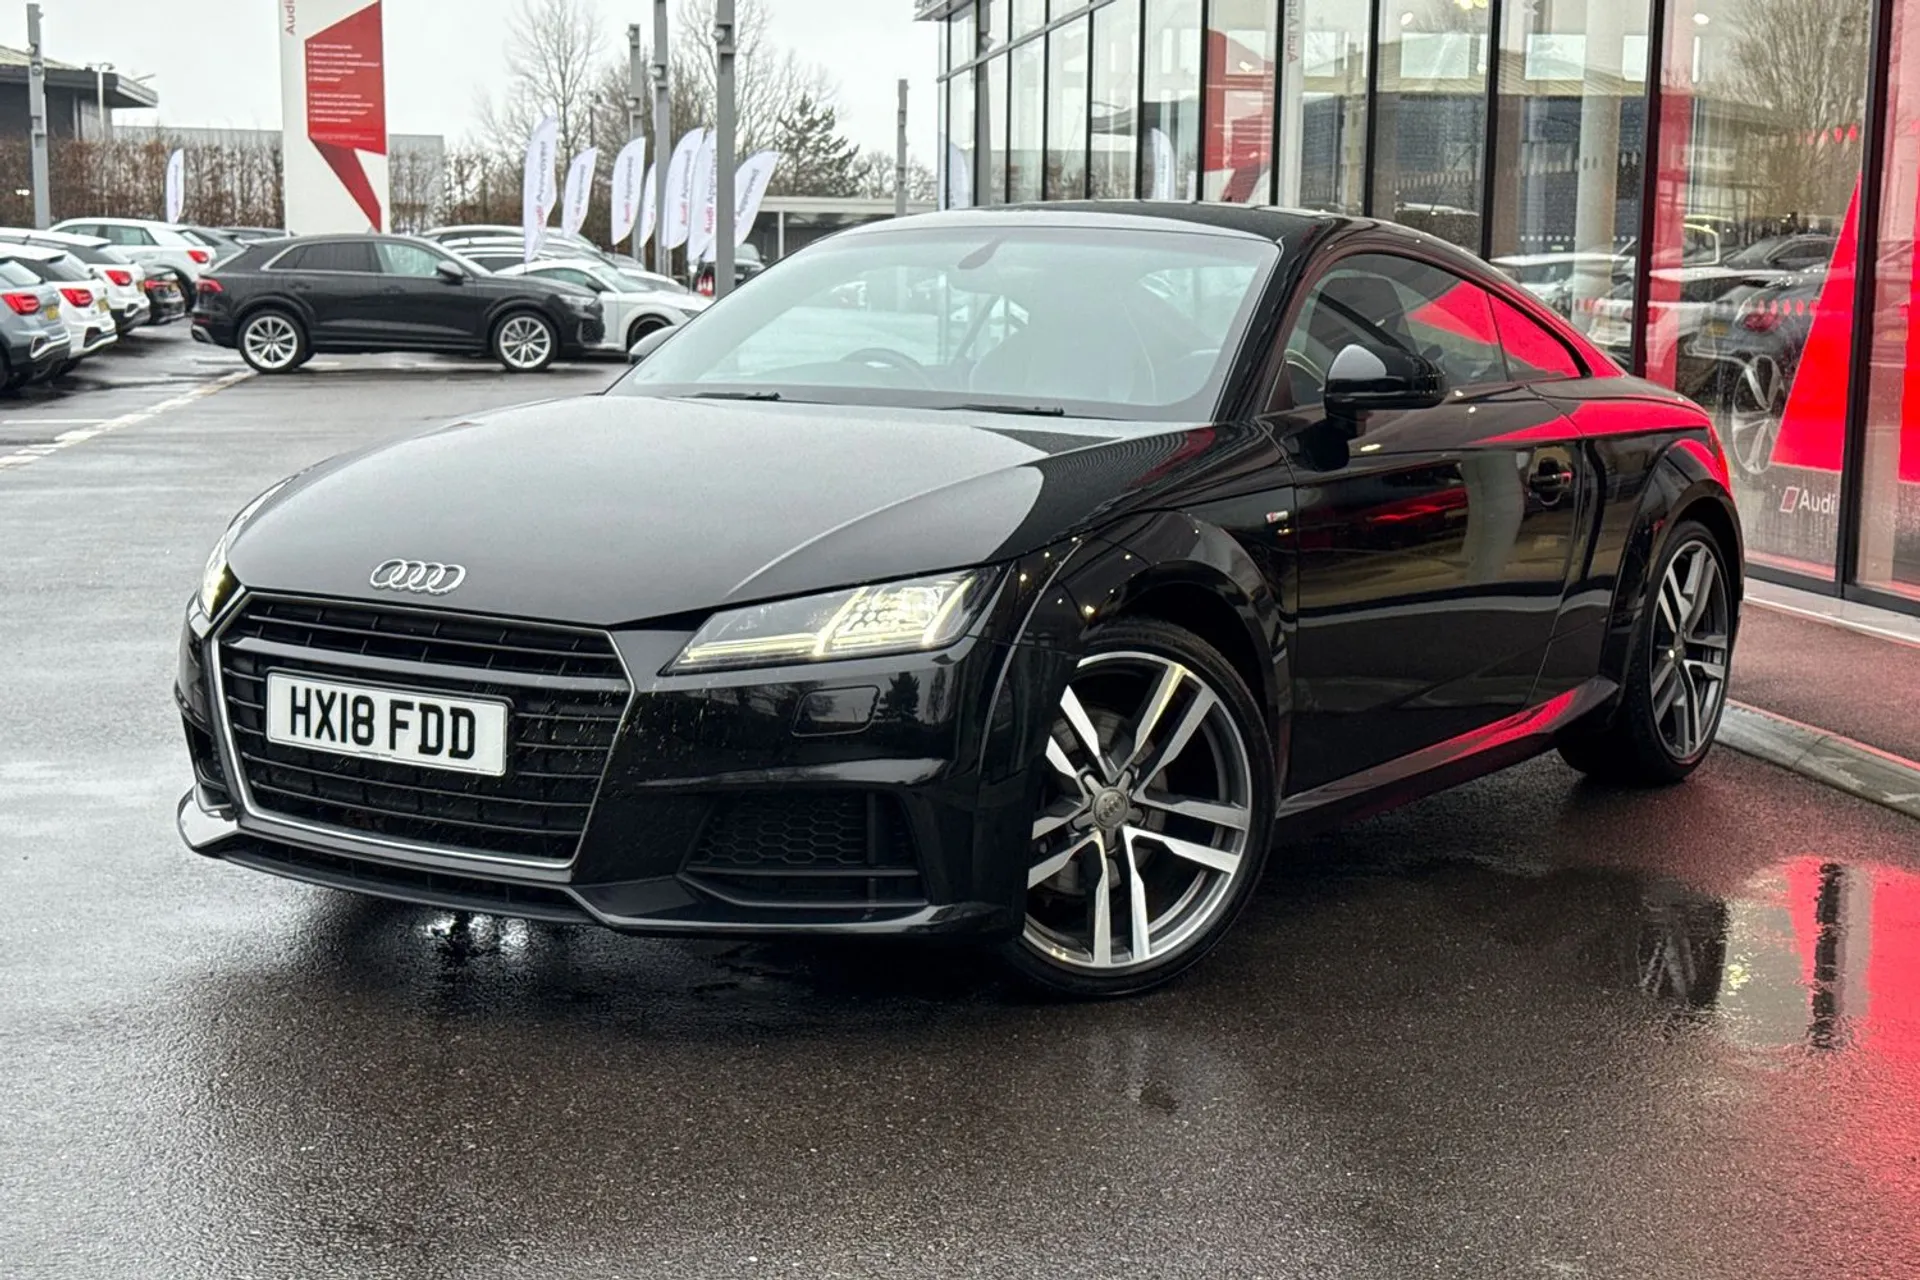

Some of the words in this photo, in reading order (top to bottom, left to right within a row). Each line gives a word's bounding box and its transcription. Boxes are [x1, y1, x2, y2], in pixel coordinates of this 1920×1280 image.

[704, 206, 714, 235] Audi
[1799, 489, 1836, 514] Audi
[290, 686, 375, 747] HX18
[389, 698, 476, 761] FDD
